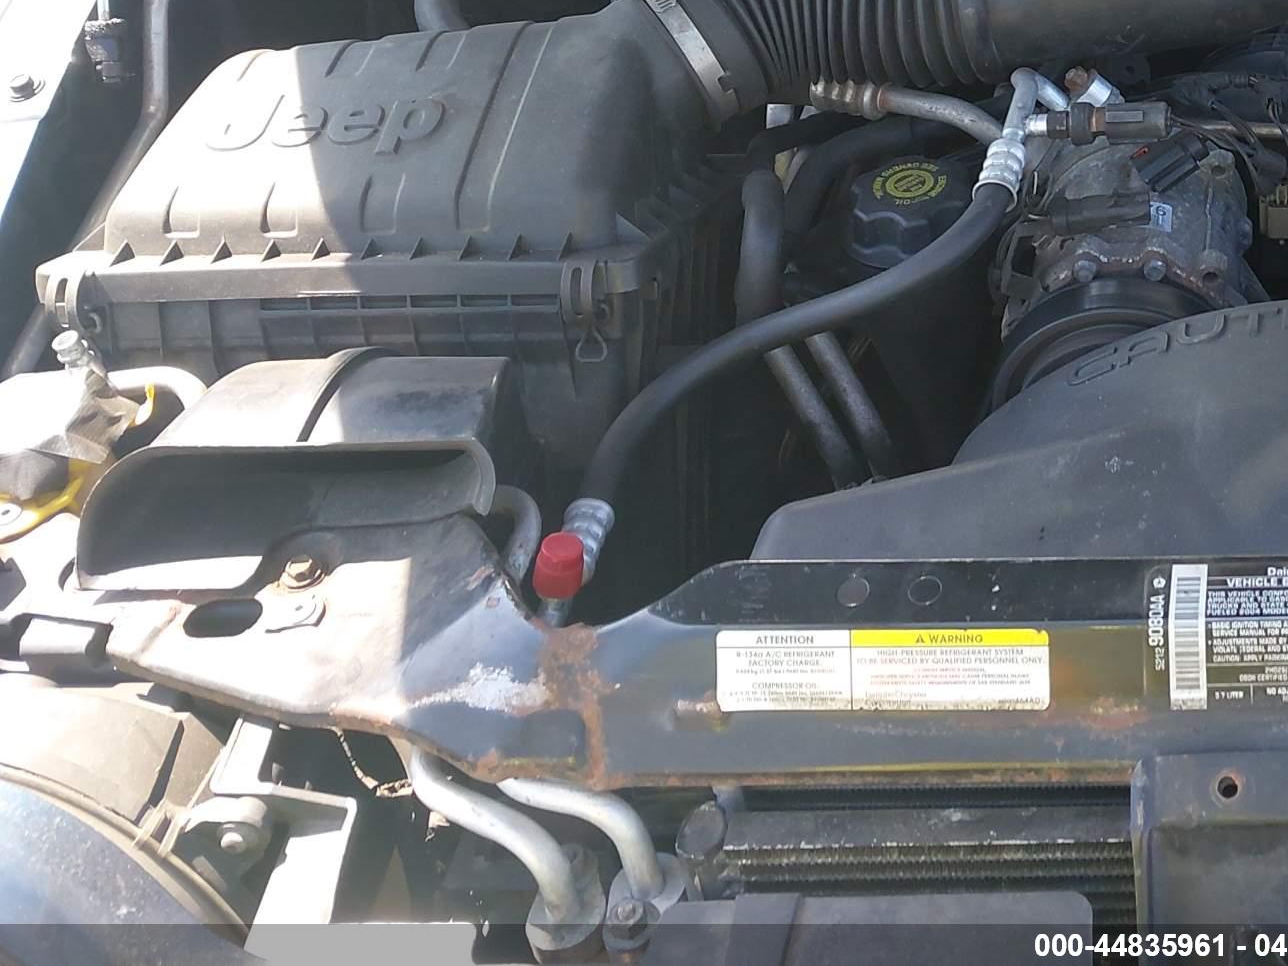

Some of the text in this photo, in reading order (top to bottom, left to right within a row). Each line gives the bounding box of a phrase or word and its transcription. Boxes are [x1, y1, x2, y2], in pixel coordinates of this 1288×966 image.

[206, 94, 446, 155] Jeep
[1226, 577, 1277, 587] VEHICLE
[1212, 621, 1231, 629] BASIC
[1231, 620, 1258, 629] IGNITION
[1260, 620, 1282, 628] TIMING
[1212, 629, 1238, 637] SERVICE
[1239, 628, 1266, 636] MANUAL
[1267, 628, 1280, 636] FOR
[755, 635, 814, 644] ATTENTION
[929, 634, 983, 644] WARNING
[1212, 637, 1257, 645] ADJUSTMENTS
[1259, 637, 1277, 645] MADE
[1278, 636, 1287, 644] BY
[1267, 644, 1281, 652] AND
[880, 657, 918, 665] SERVICED
[920, 657, 930, 665] BY
[931, 657, 972, 666] QUALIFIED
[974, 657, 1019, 665] PERSONNEL
[1243, 654, 1262, 662] APPLY
[748, 659, 785, 667] FACTORY
[752, 682, 804, 690] COMPRESSOR
[1266, 686, 1276, 695] NO
[1226, 690, 1244, 699] LITER
